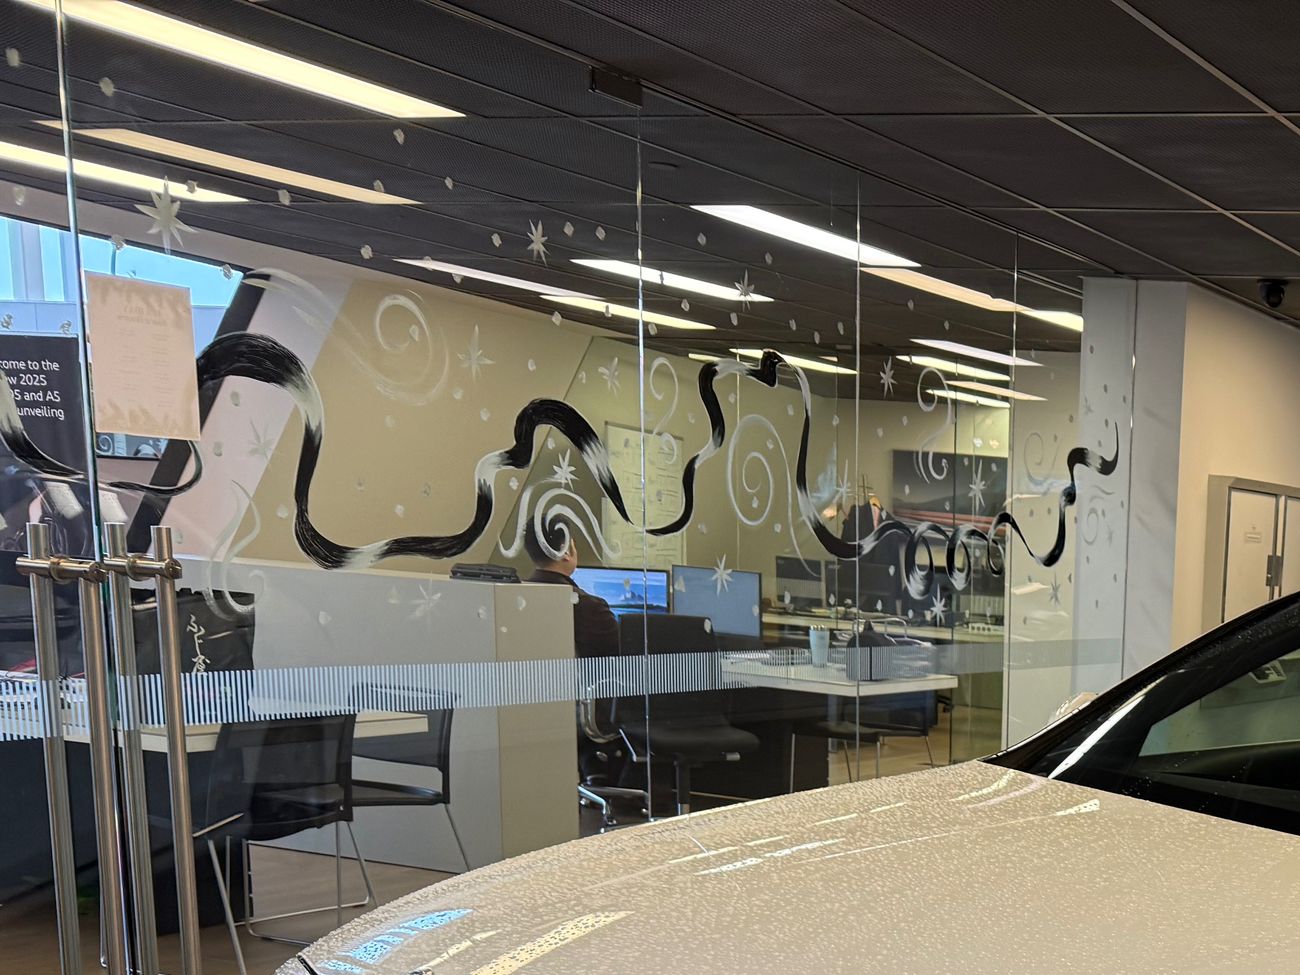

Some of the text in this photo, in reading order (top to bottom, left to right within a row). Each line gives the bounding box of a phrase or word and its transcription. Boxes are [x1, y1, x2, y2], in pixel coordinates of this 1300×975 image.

[28, 360, 40, 371] to
[41, 358, 60, 371] the
[20, 374, 48, 386] 2025
[24, 391, 43, 402] and
[46, 391, 61, 402] A5
[17, 406, 65, 420] unveiling
